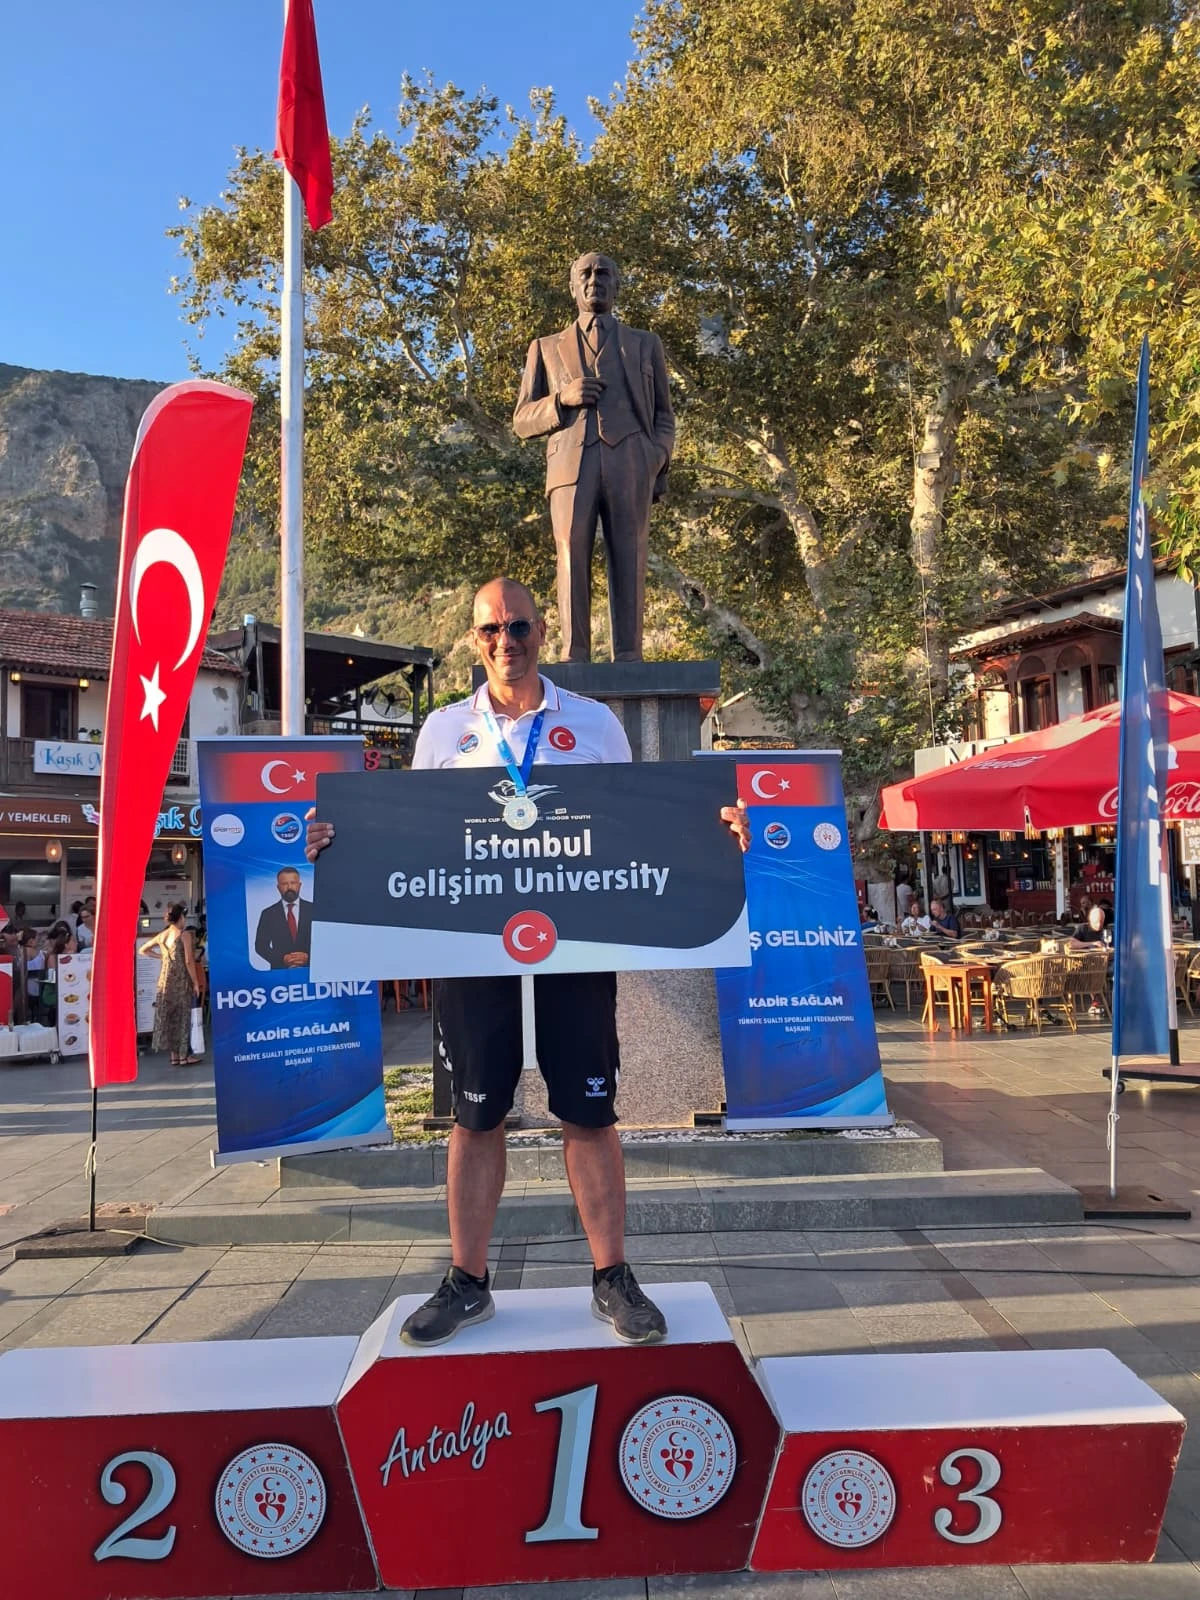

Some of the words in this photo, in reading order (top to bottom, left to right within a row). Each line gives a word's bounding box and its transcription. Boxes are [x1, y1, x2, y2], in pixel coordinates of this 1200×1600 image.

[41, 746, 84, 770] Kaşık
[465, 828, 592, 860] İstanbul
[387, 867, 503, 904] Gelişim
[514, 861, 670, 896] University
[765, 925, 858, 947] GELDİNİZ
[216, 987, 267, 1009] HOŞ
[749, 995, 789, 1008] KADİR
[791, 994, 843, 1007] SAĞLAM
[738, 1016, 761, 1024] TÜRKİYE
[763, 1016, 783, 1024] SUALTI
[784, 1015, 813, 1023] SPORLARI
[785, 1025, 810, 1034] BAŞKANI
[246, 1027, 290, 1043] KADİR
[292, 1021, 350, 1038] SAĞLAM
[234, 1053, 261, 1063] TÜRKİYE
[262, 1050, 283, 1059] SUALTI
[285, 1047, 315, 1057] SPORLARI
[316, 1042, 360, 1053] FEDERASYONU
[285, 1057, 313, 1067] BAŞKANI
[380, 1401, 512, 1487] Antalya
[645, 1469, 670, 1493] TÜRKİYE
[664, 1418, 696, 1428] GENÇLİK
[696, 1425, 705, 1435] VE
[703, 1435, 714, 1455] SPOR
[525, 1384, 599, 1543] 1
[94, 1451, 177, 1562] 2
[240, 1512, 263, 1534] TÜRKİYE
[259, 1464, 289, 1475] GENÇLİK
[289, 1472, 297, 1481] VE
[295, 1481, 305, 1499] SPOR
[935, 1448, 1002, 1544] 3
